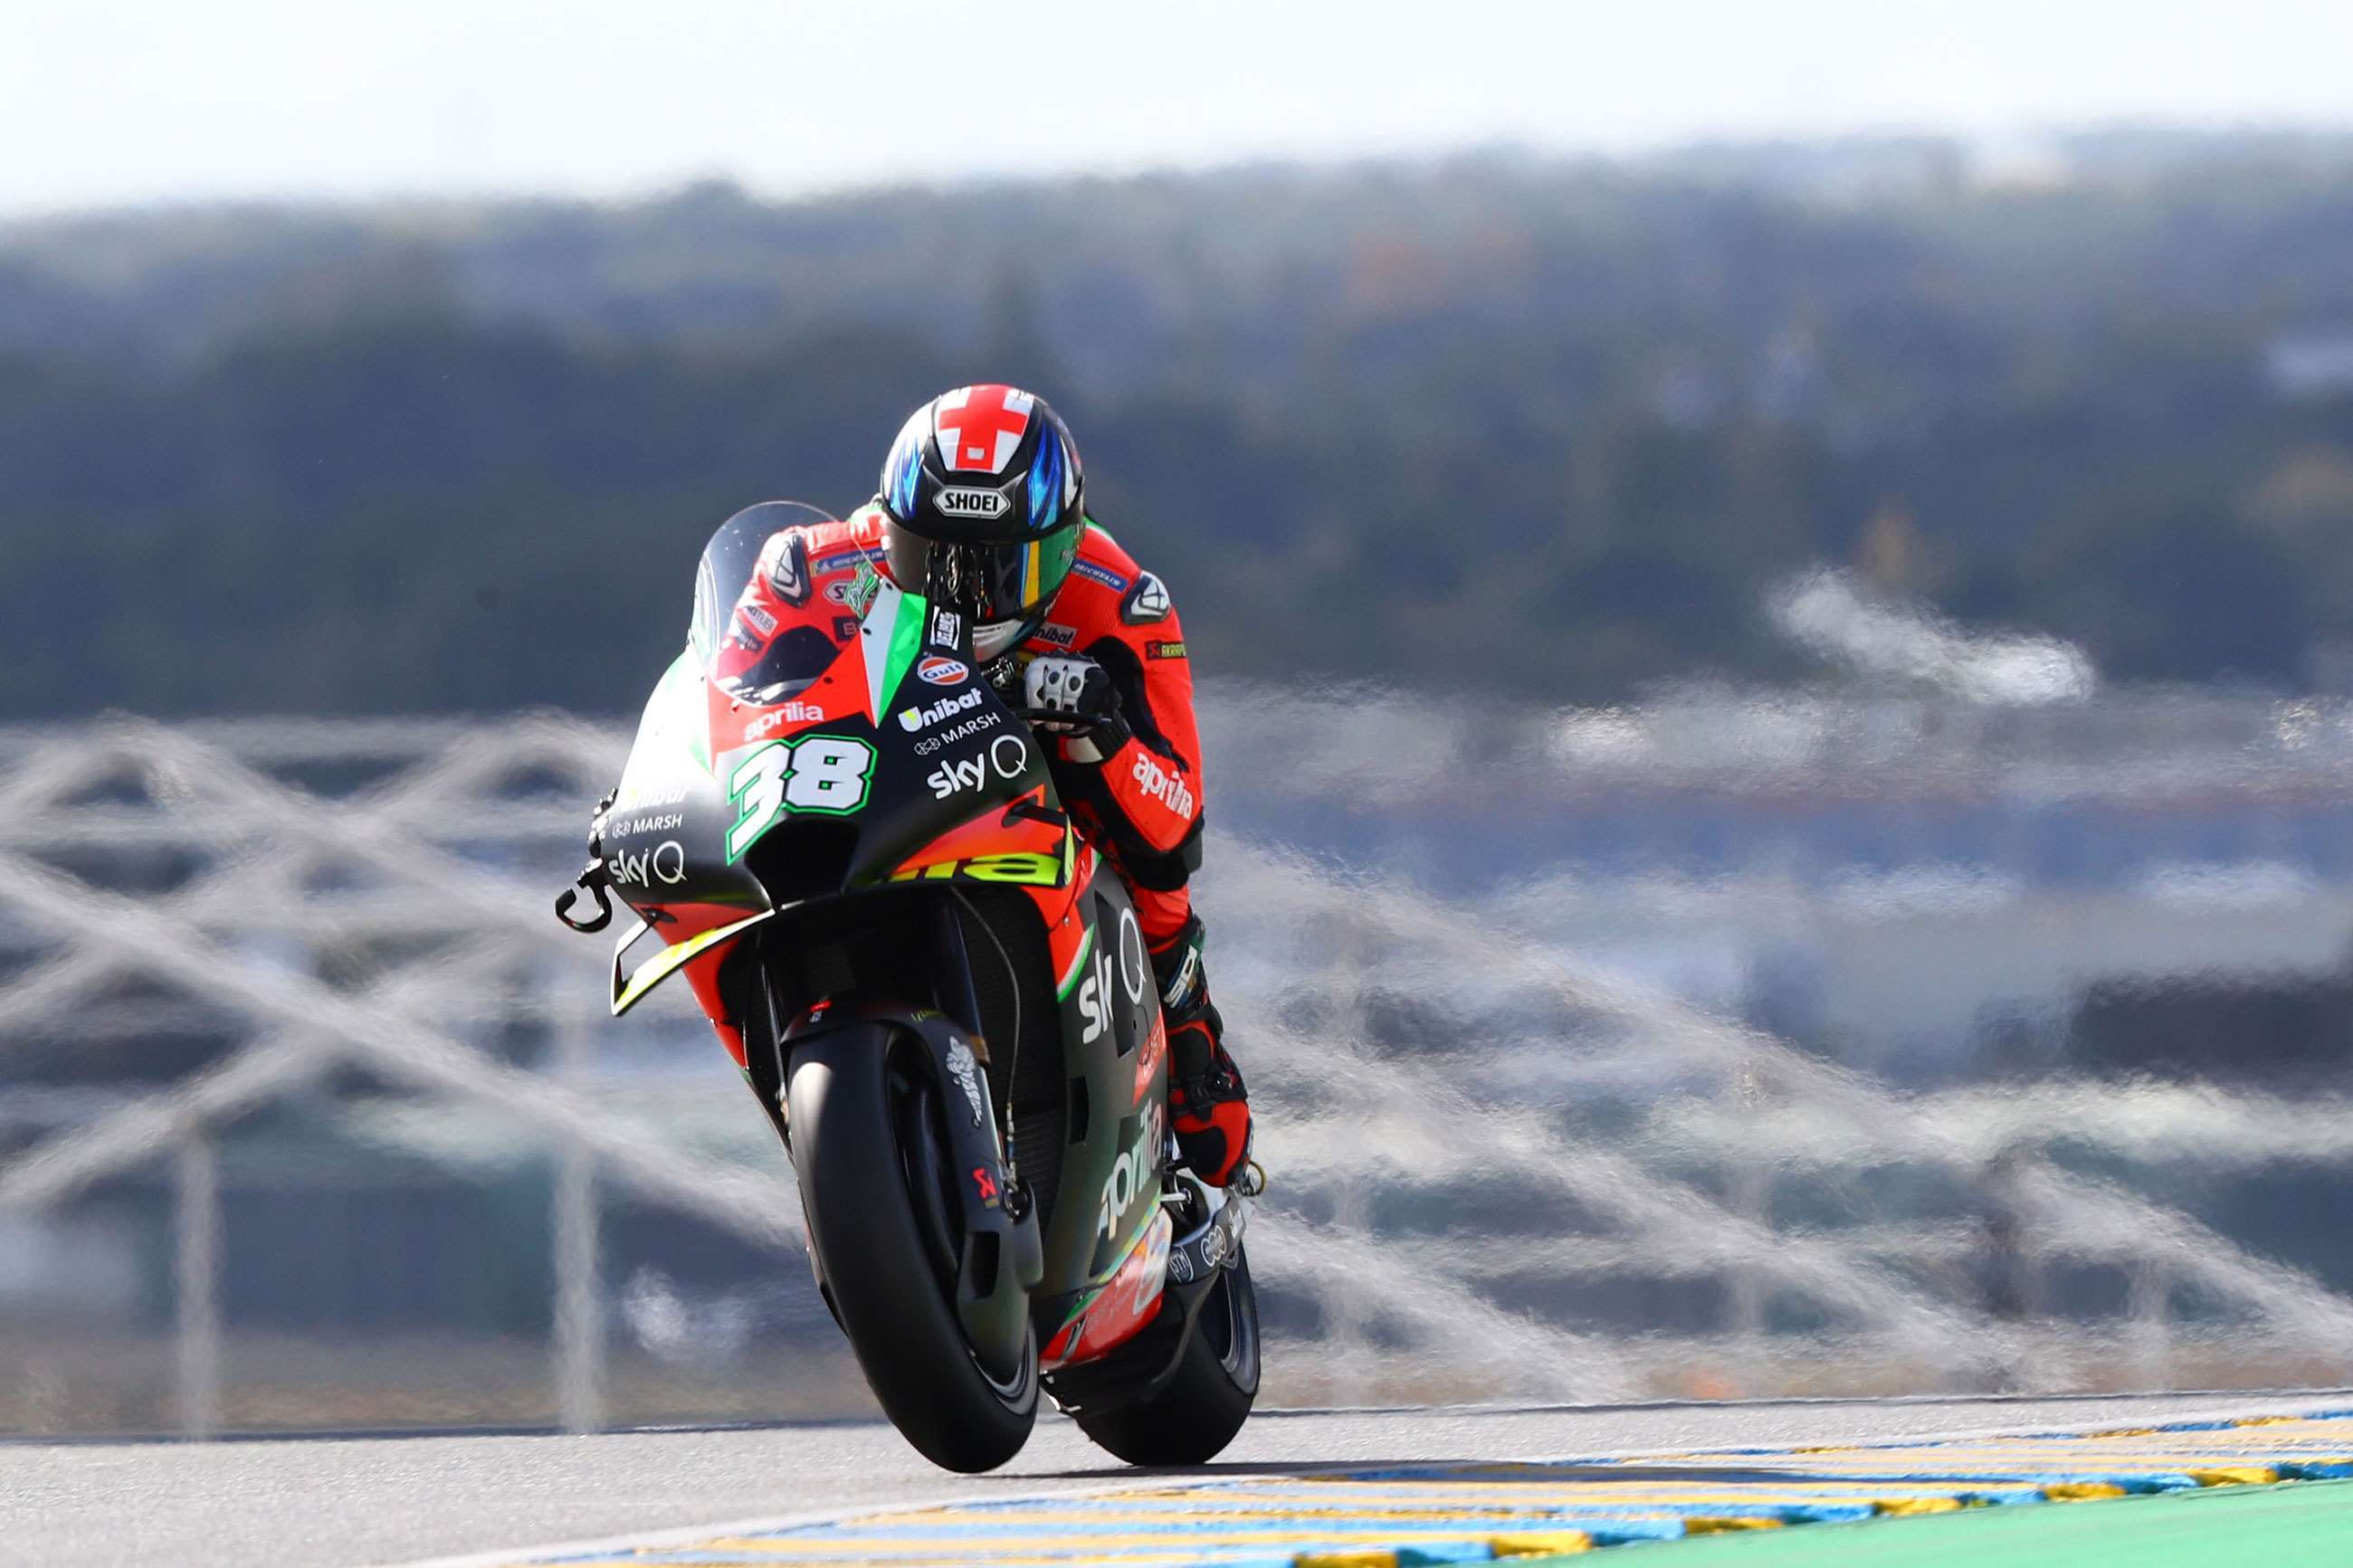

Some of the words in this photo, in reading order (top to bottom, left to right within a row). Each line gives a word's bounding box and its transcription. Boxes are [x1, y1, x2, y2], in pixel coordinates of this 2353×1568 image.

[945, 492, 999, 512] SHOEI
[1033, 628, 1074, 646] nibat
[923, 662, 964, 679] Gulf
[745, 701, 824, 741] aprilia
[898, 688, 983, 732] Unibat
[940, 712, 1001, 744] MARSH
[927, 753, 986, 800] sky
[990, 735, 1027, 778] Q
[1132, 752, 1194, 821] aprilia
[727, 735, 877, 866] 38
[633, 813, 682, 833] MARSH
[608, 848, 649, 888] sky
[653, 840, 688, 884] Q
[1119, 908, 1147, 1005] Q
